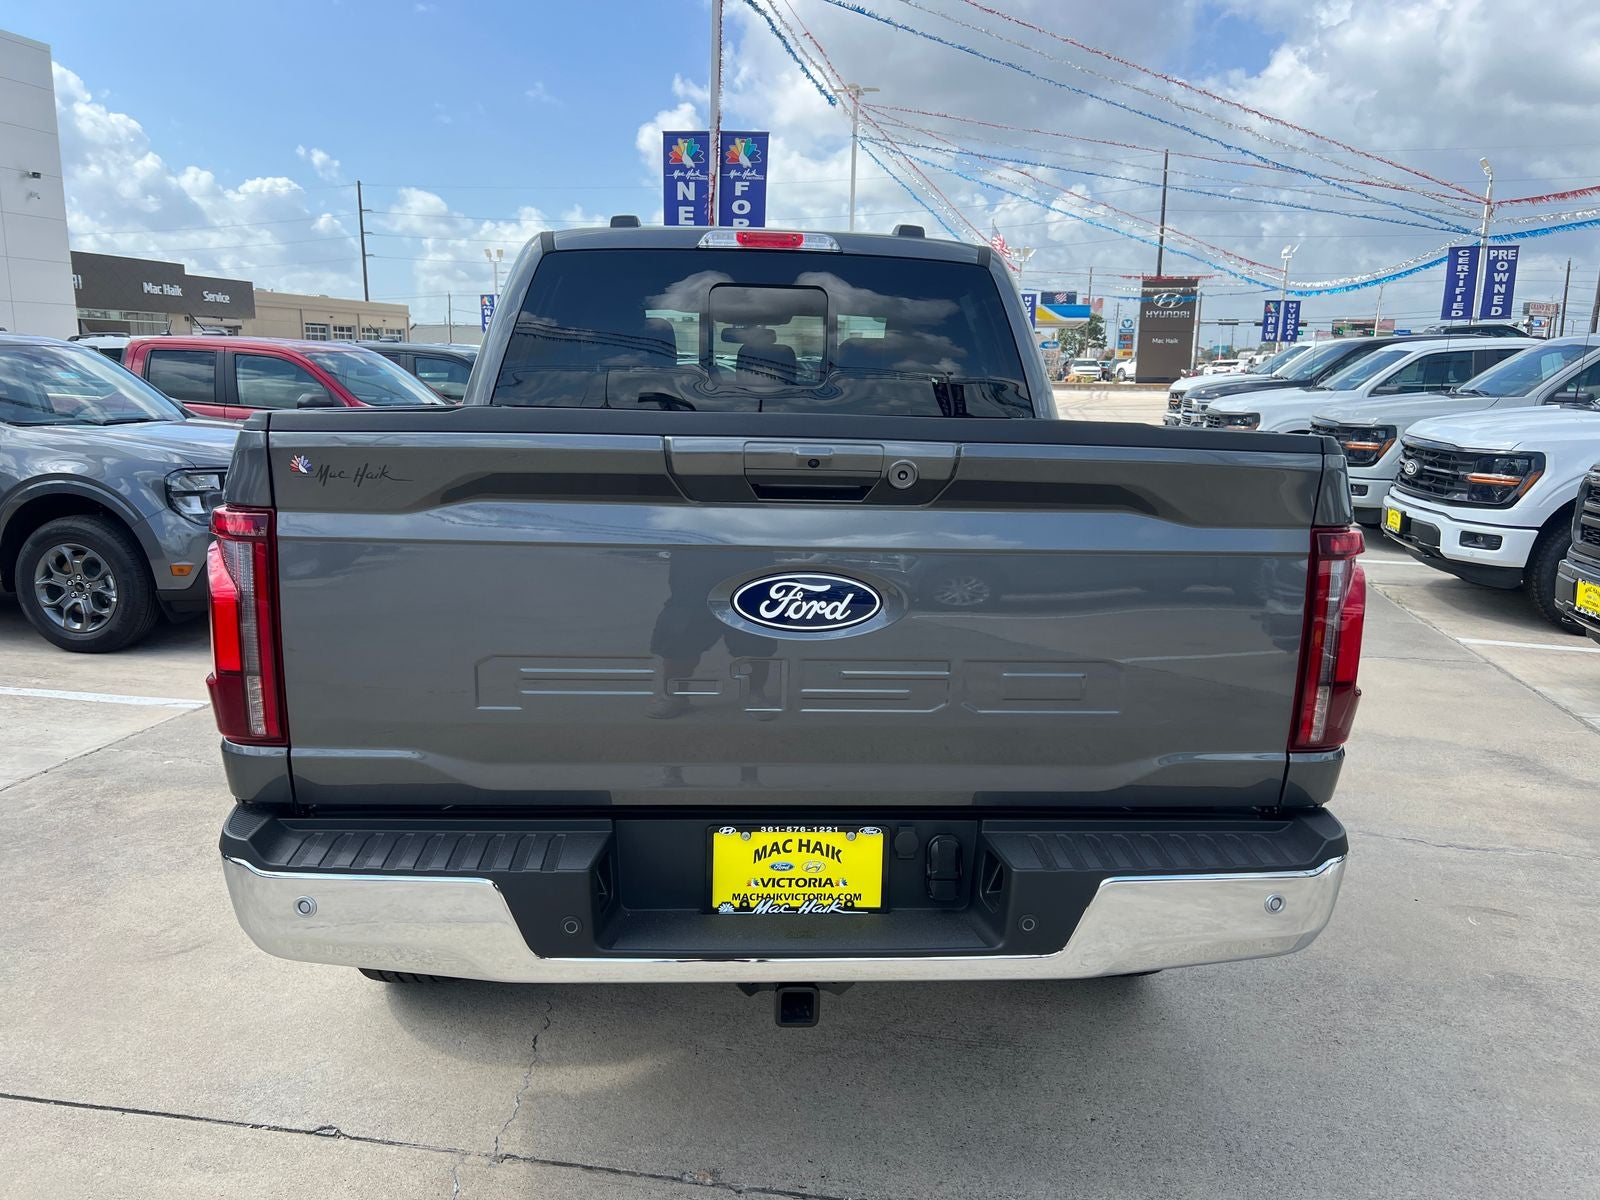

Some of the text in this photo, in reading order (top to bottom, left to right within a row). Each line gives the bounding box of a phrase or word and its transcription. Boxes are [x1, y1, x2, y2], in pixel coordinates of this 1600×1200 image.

[677, 181, 696, 226] NE
[1489, 249, 1517, 261] PRE
[142, 281, 183, 297] Mac Haik
[1451, 249, 1470, 317] CERTIFIED
[1490, 261, 1509, 317] OWNED
[202, 290, 230, 304] Service
[1145, 310, 1190, 319] HYUNDAI
[1286, 302, 1297, 340] HYUNDAI
[1264, 316, 1276, 340] NEW
[315, 462, 414, 488] Mac Haik
[759, 581, 855, 620] Ford
[753, 838, 843, 864] MAC HAIK
[760, 877, 835, 888] VICTORIA
[731, 893, 862, 901] MACHAIKVICTORIA.COM
[751, 899, 868, 914] Mac Haik
